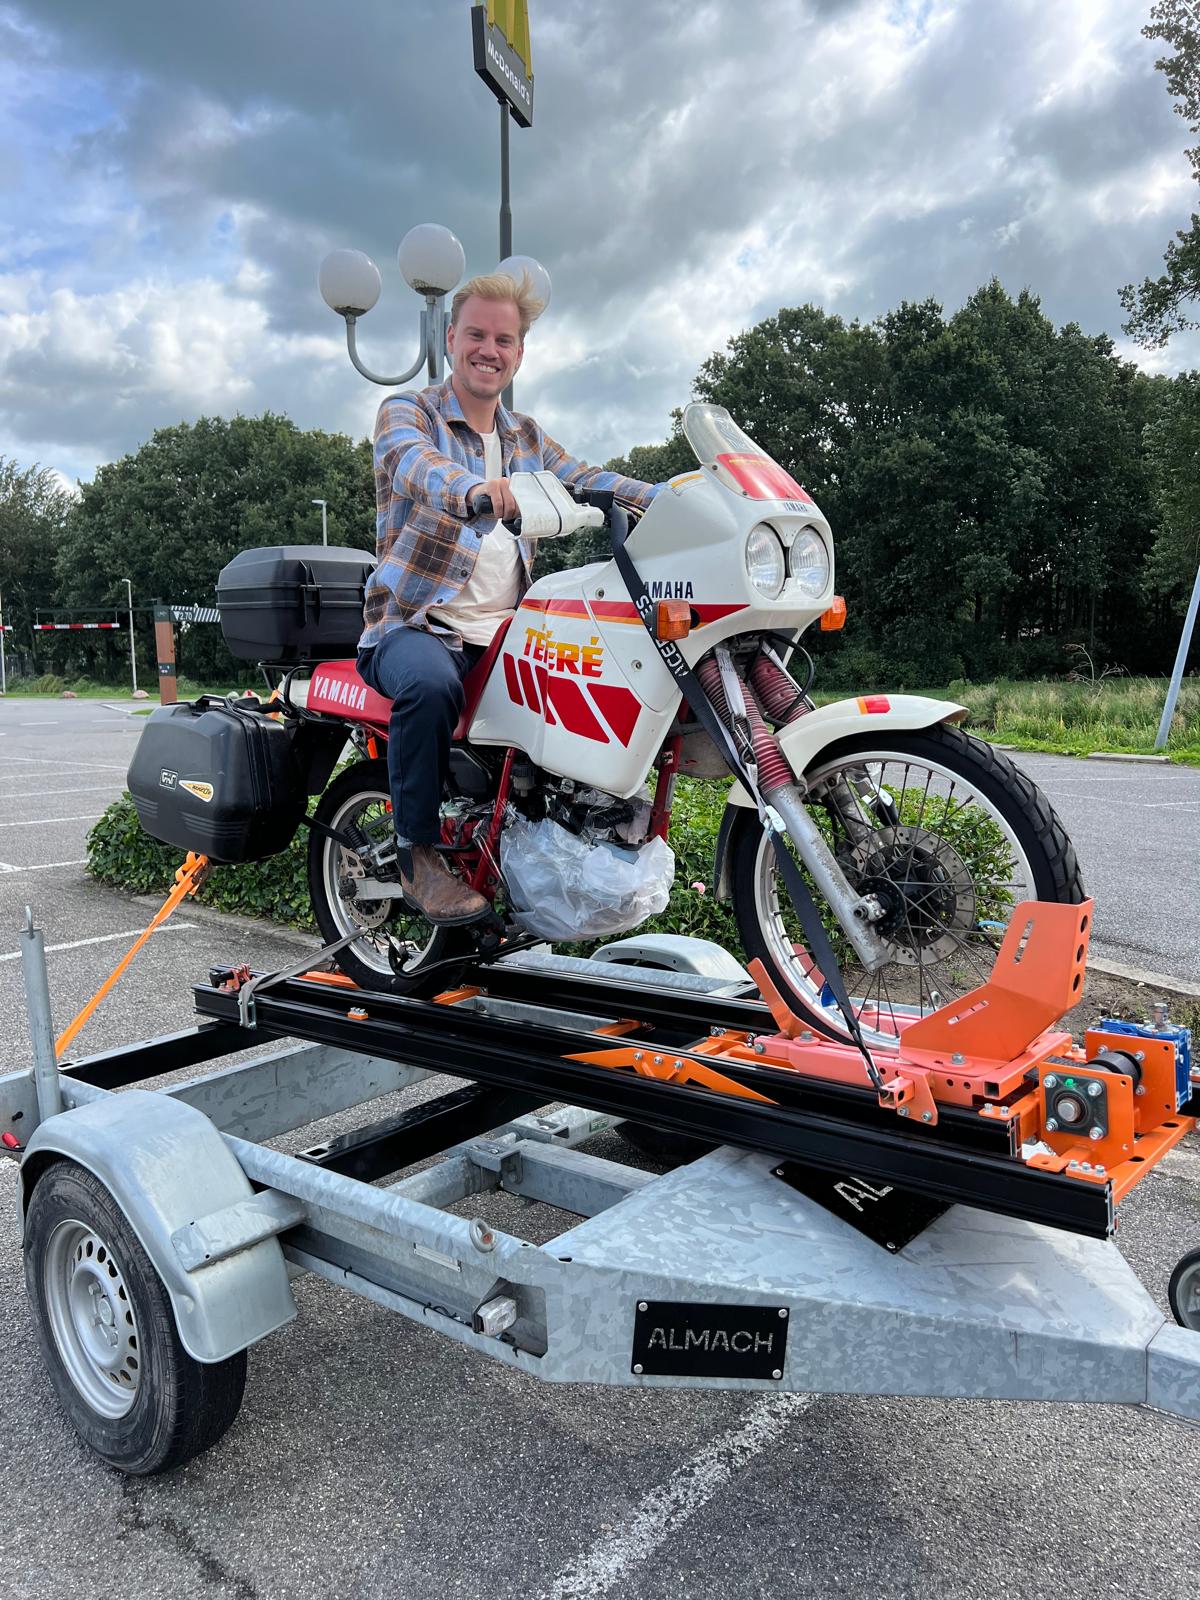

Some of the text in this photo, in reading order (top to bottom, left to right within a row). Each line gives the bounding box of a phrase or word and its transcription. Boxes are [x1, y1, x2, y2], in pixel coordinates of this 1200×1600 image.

[488, 39, 530, 105] McDonald's
[644, 581, 694, 599] AMAHA
[313, 675, 368, 711] YAMAHA
[647, 1327, 774, 1354] ALMACH
